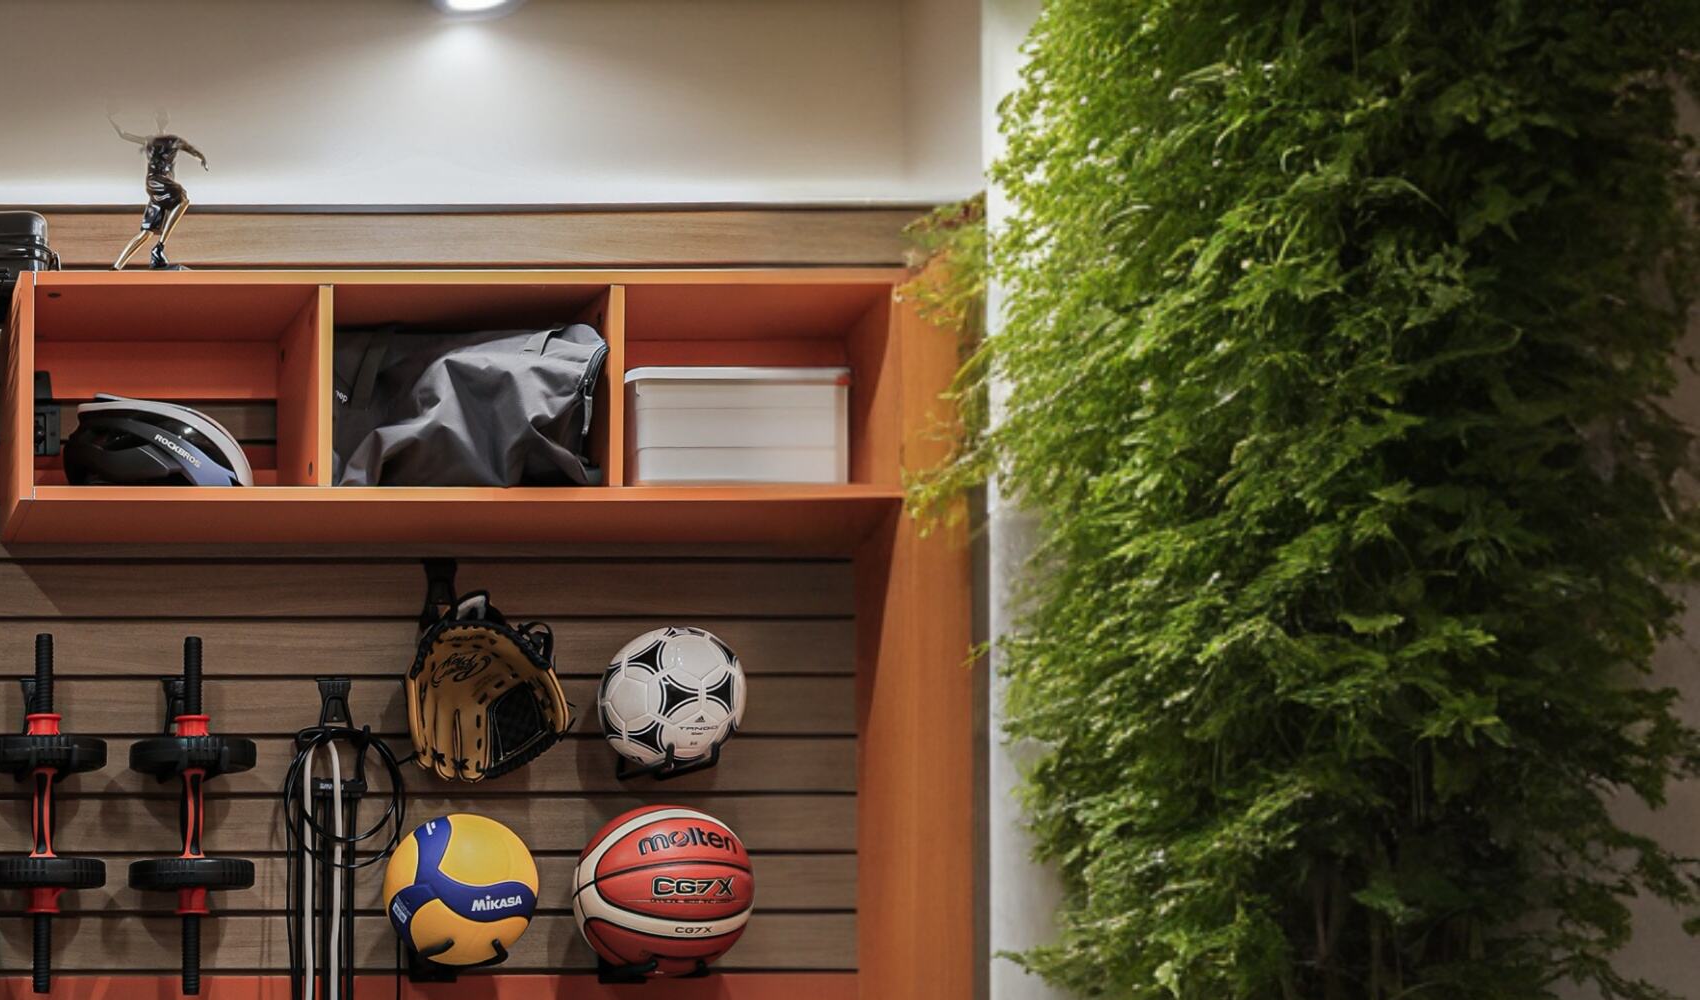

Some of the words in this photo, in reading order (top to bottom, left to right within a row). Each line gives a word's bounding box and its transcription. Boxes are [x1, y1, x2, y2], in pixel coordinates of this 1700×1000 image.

[638, 827, 738, 856] molten
[651, 875, 736, 897] CG7X
[674, 926, 713, 934] CG7X
